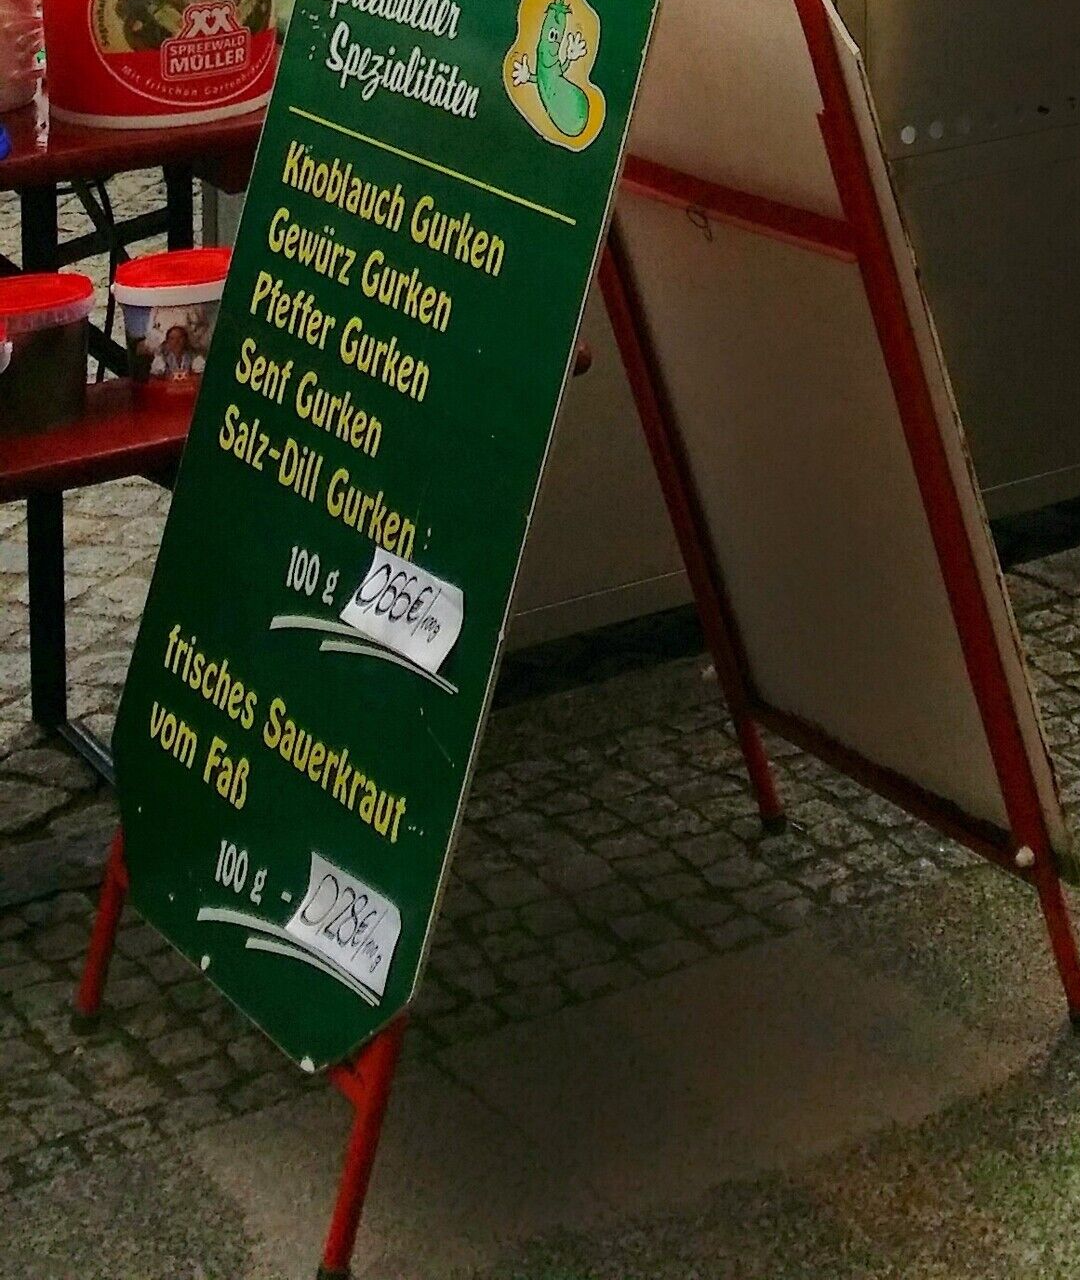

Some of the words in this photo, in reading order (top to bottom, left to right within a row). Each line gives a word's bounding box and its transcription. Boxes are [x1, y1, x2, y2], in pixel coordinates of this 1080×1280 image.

[169, 35, 246, 57] SPREEWALD
[169, 48, 246, 74] MÜLLER
[326, 21, 480, 119] Spezialitäten
[282, 140, 405, 233] Knoblauch
[410, 195, 505, 277] Gurken
[268, 207, 357, 286] Gewürz
[361, 250, 452, 332] Gurken
[250, 270, 336, 350] Pfeffer
[340, 316, 430, 402] Gurken
[235, 338, 294, 405] Senf
[296, 371, 382, 458] Gurken
[219, 404, 324, 503] Salz-Dill
[326, 468, 416, 561] Gurken
[286, 545, 320, 596] 100
[322, 569, 340, 606] g
[150, 701, 198, 770] vom
[203, 736, 250, 811] Faß
[163, 624, 257, 730] frisches
[263, 697, 406, 844] Sauerkraut
[215, 840, 249, 894] 100
[250, 868, 268, 906] g
